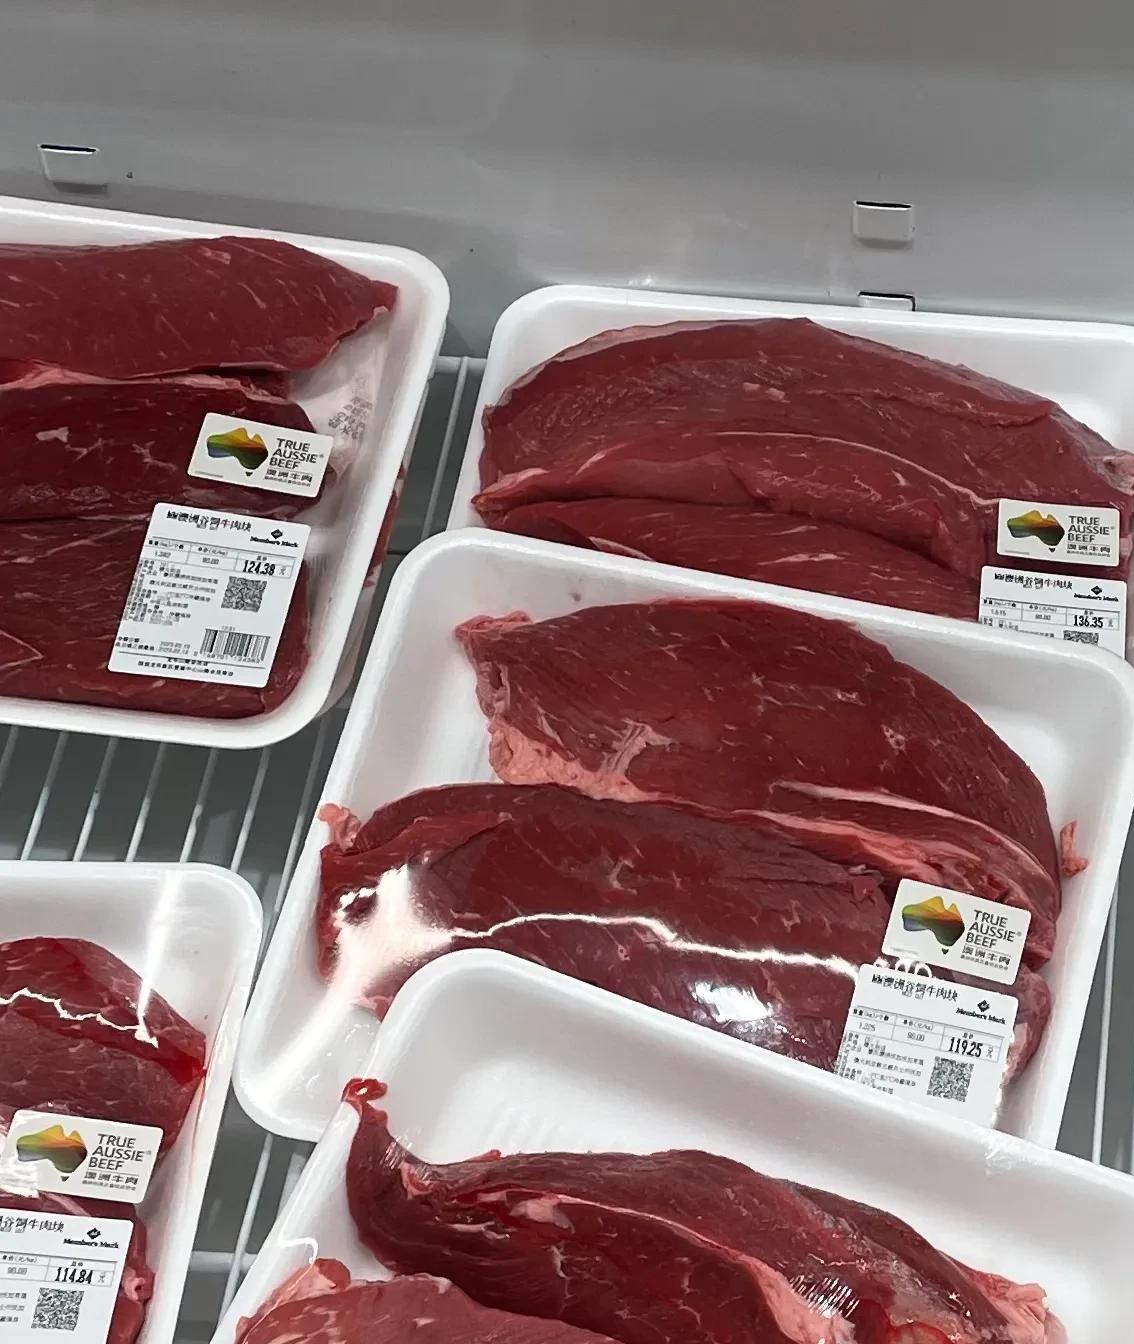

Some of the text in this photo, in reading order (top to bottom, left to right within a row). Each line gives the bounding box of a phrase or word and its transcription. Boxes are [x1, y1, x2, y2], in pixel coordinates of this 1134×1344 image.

[277, 437, 311, 453] TRUE
[269, 457, 300, 470] BEEF
[272, 448, 318, 464] AUSSIE
[1068, 515, 1100, 526] TRUE
[1067, 524, 1111, 536] AUSSIE
[1067, 532, 1096, 543] BEEF
[243, 560, 276, 576] 124.38
[1073, 614, 1103, 628] 136.35
[973, 909, 1008, 928] TRUE
[969, 921, 1015, 942] AUSSIE
[966, 933, 997, 949] BEEF
[950, 1037, 983, 1058] 119.25
[98, 1133, 136, 1149] TRUE
[92, 1145, 144, 1162] AUSSIE
[88, 1156, 124, 1171] BEEF
[55, 1267, 93, 1284] 114.84
